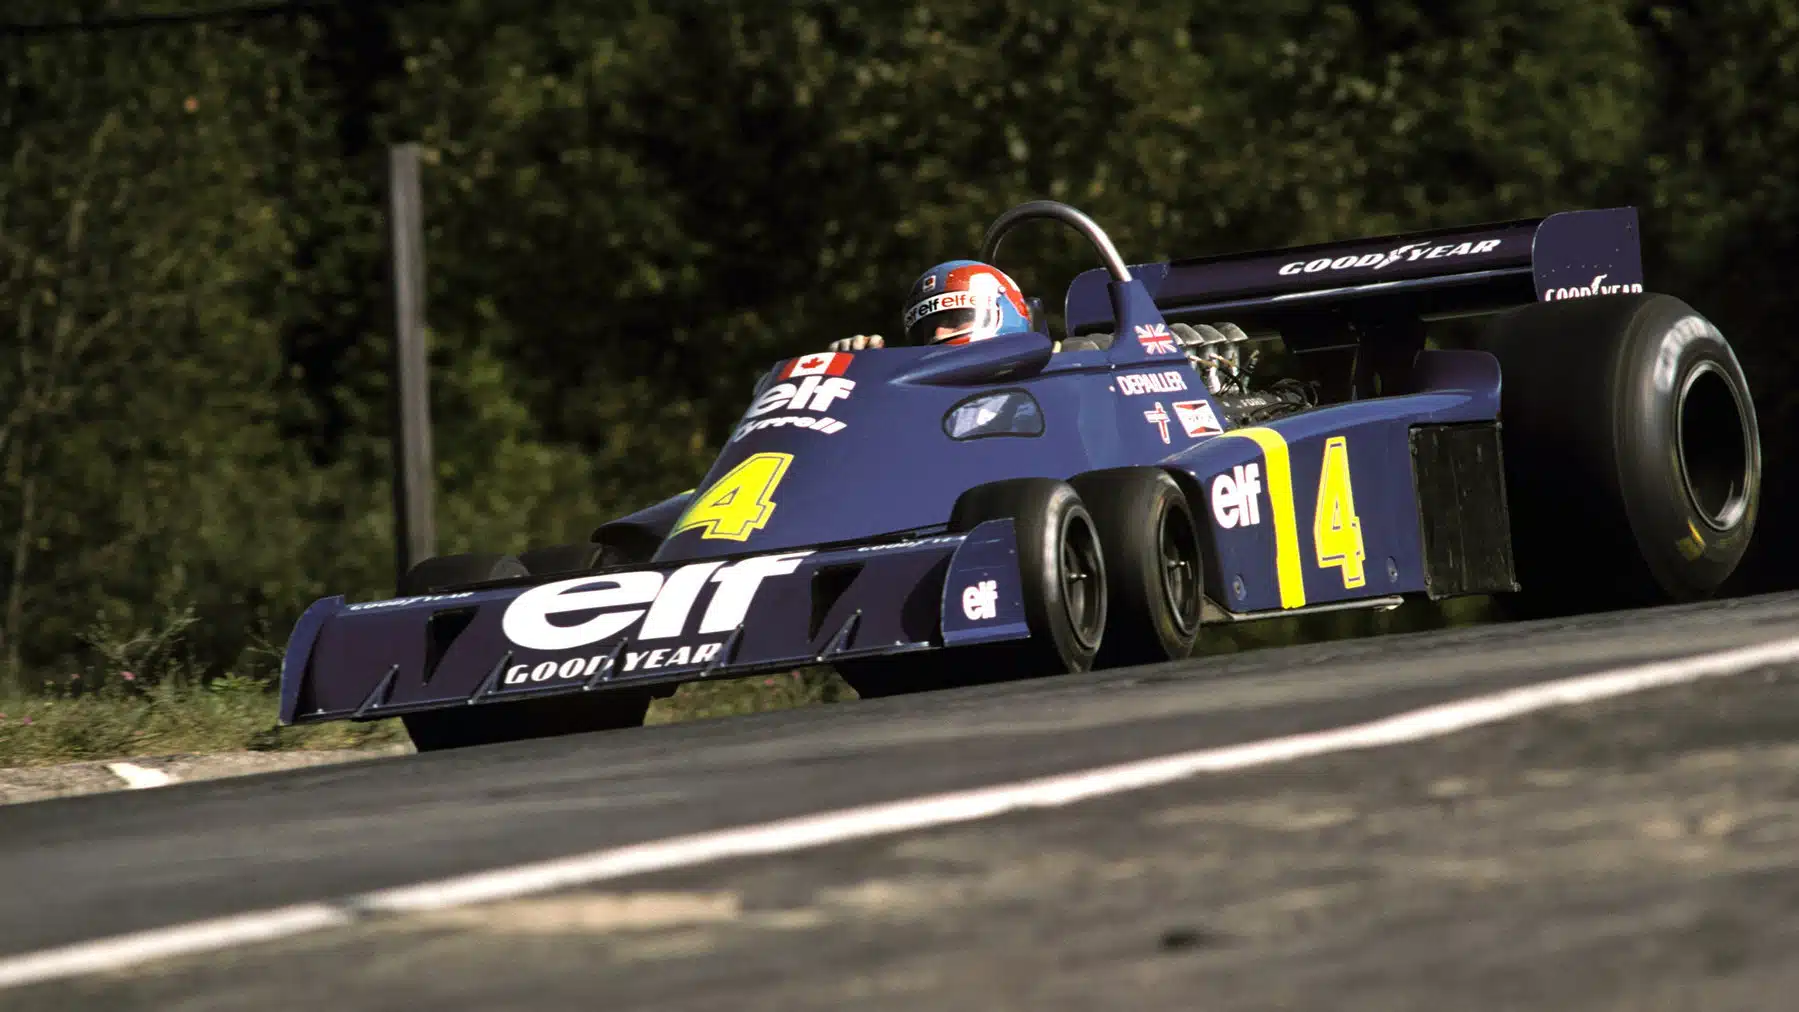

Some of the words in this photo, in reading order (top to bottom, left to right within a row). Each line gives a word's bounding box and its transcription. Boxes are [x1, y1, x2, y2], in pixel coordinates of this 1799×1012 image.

[1278, 239, 1501, 276] GOODYEAR
[918, 298, 939, 317] elf
[941, 294, 966, 308] elf
[745, 375, 856, 419] elf
[1116, 371, 1188, 396] DEPAILLER
[733, 416, 848, 443] yrrell
[668, 452, 795, 542] 4
[1211, 463, 1261, 529] elf
[1313, 436, 1366, 589] 4
[502, 551, 818, 651] elf
[962, 580, 998, 620] elf
[504, 643, 722, 684] GOODYEAR
